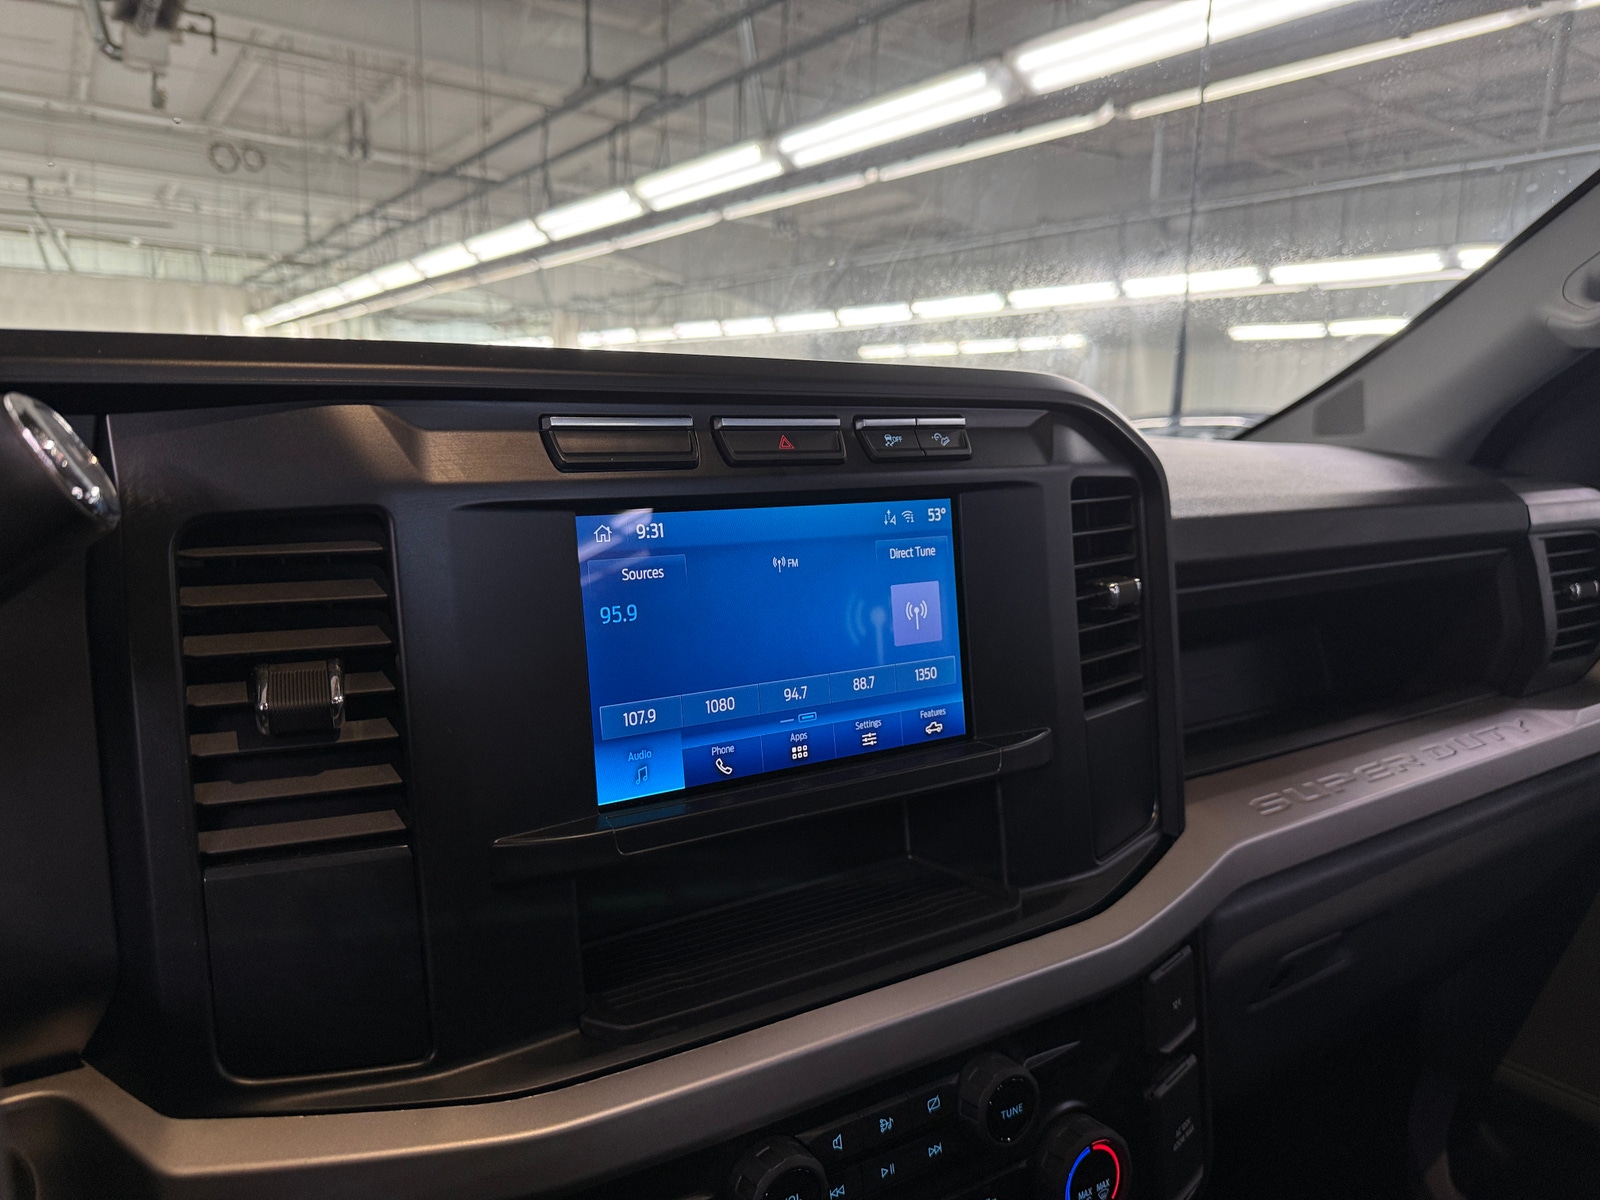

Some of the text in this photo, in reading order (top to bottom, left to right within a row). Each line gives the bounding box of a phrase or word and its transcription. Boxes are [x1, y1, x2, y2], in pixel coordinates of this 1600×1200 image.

[927, 507, 947, 522] 53°
[635, 522, 665, 540] 9:31
[889, 546, 937, 559] Direct Tune
[787, 558, 799, 568] FM
[621, 568, 665, 581] Sources
[600, 604, 638, 625] 95.9
[914, 666, 938, 682] 1350
[852, 675, 875, 691] 88.7
[783, 685, 808, 702] 94.7
[705, 696, 736, 714] 1080
[622, 708, 657, 727] 107.9
[920, 707, 947, 719] Features
[855, 718, 882, 731] Settings
[790, 731, 808, 743] Apps
[627, 749, 652, 762] Audio
[711, 744, 735, 756] Phone
[1249, 717, 1530, 816] SUPER DUTY
[1000, 1102, 1024, 1120] TUNE
[1096, 1178, 1110, 1192] MAX
[1078, 1187, 1093, 1200] MAX
